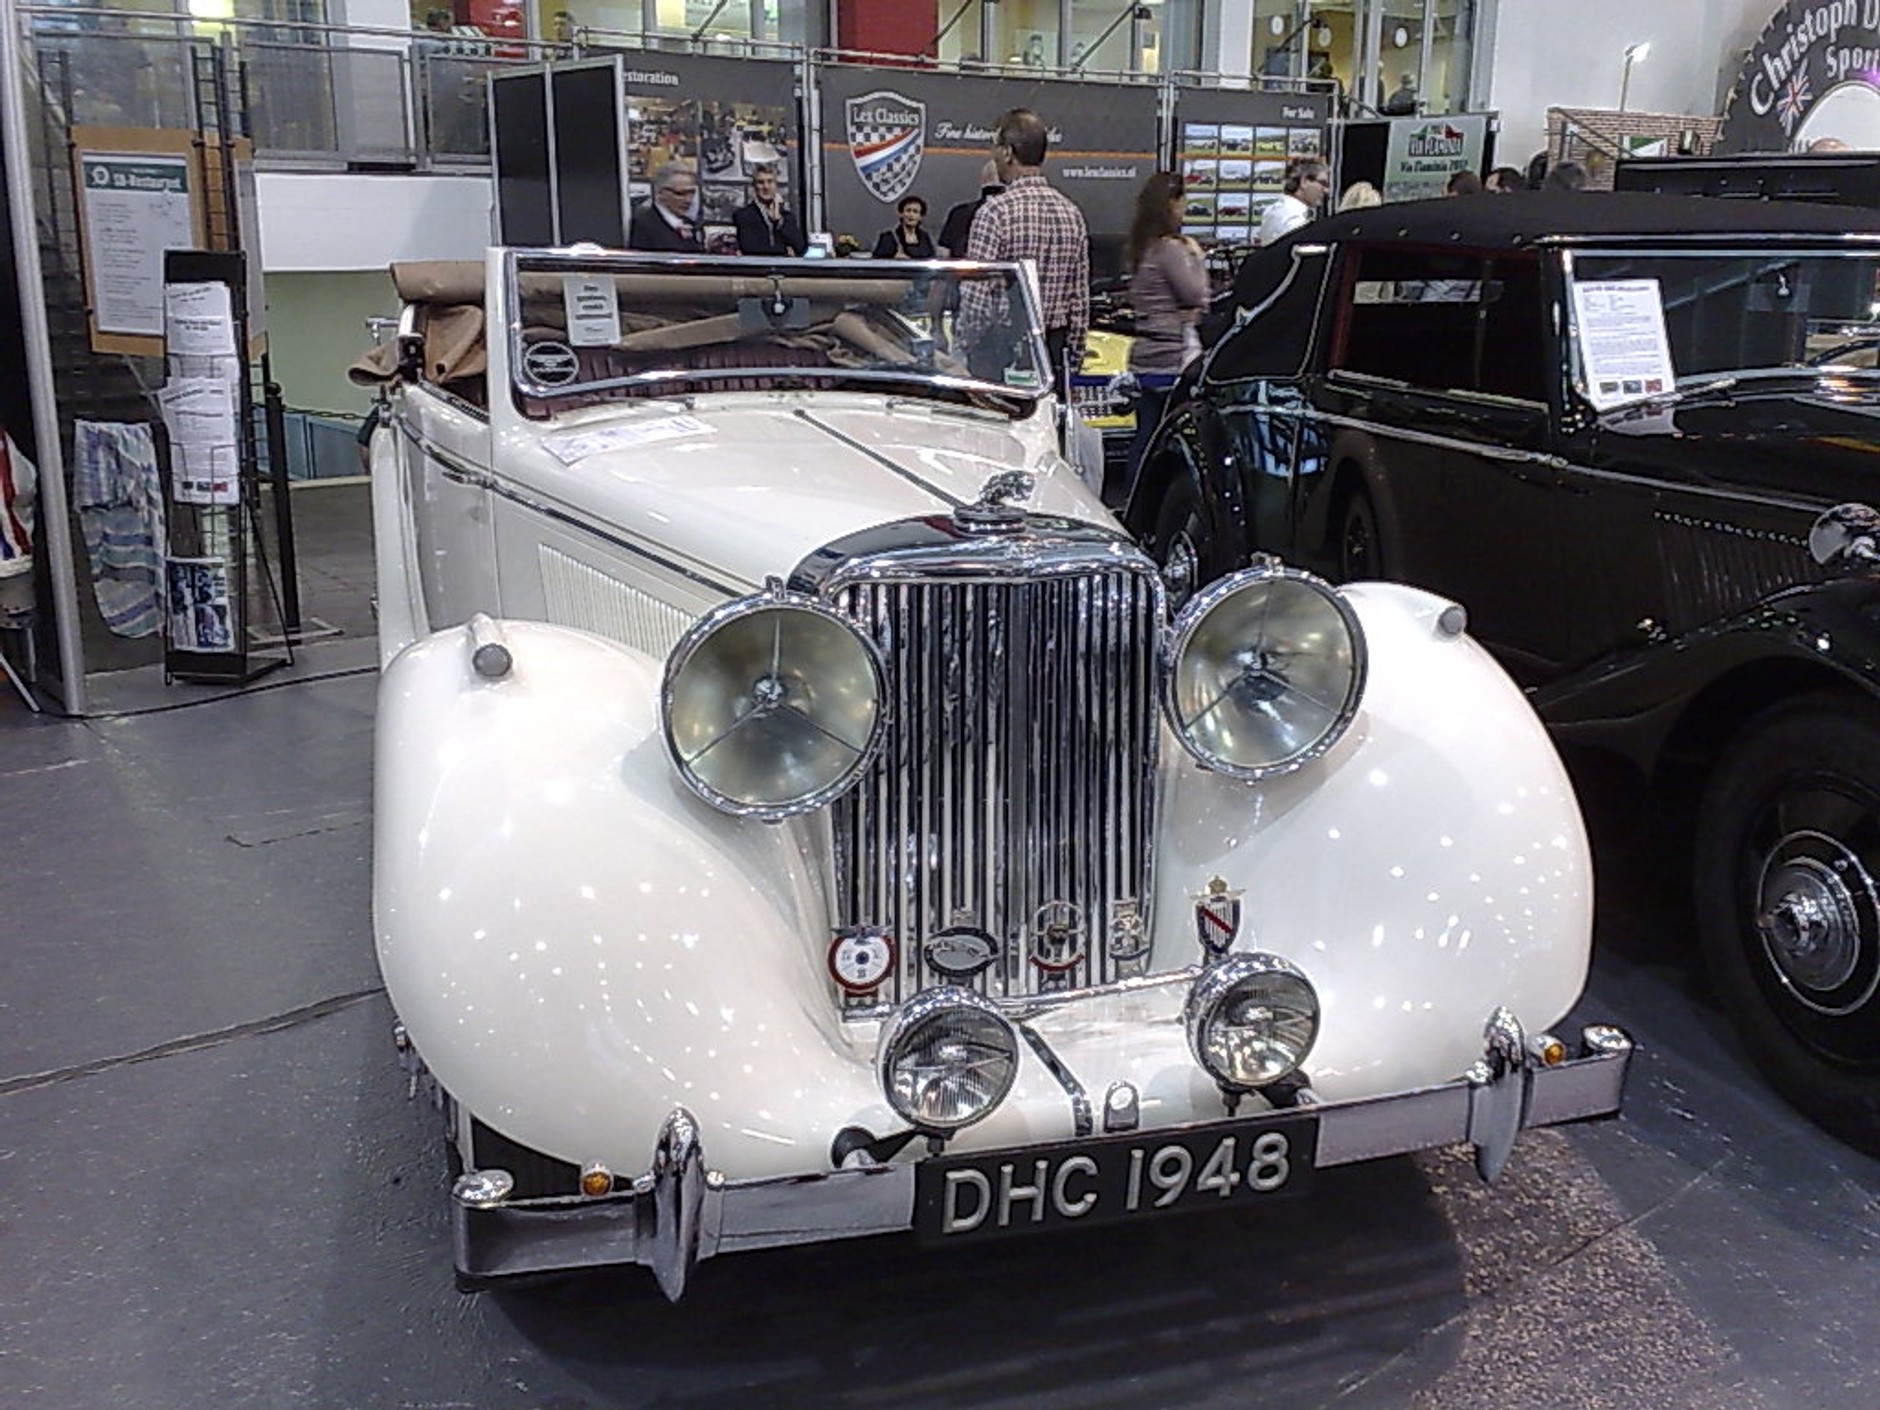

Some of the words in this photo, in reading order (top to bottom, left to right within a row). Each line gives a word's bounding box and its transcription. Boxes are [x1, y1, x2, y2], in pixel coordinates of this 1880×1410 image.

[1750, 0, 1857, 115] Christoph
[853, 106, 873, 123] Lex
[875, 107, 919, 126] Classics
[943, 1155, 1099, 1234] DHC
[1126, 1131, 1290, 1211] 1948
